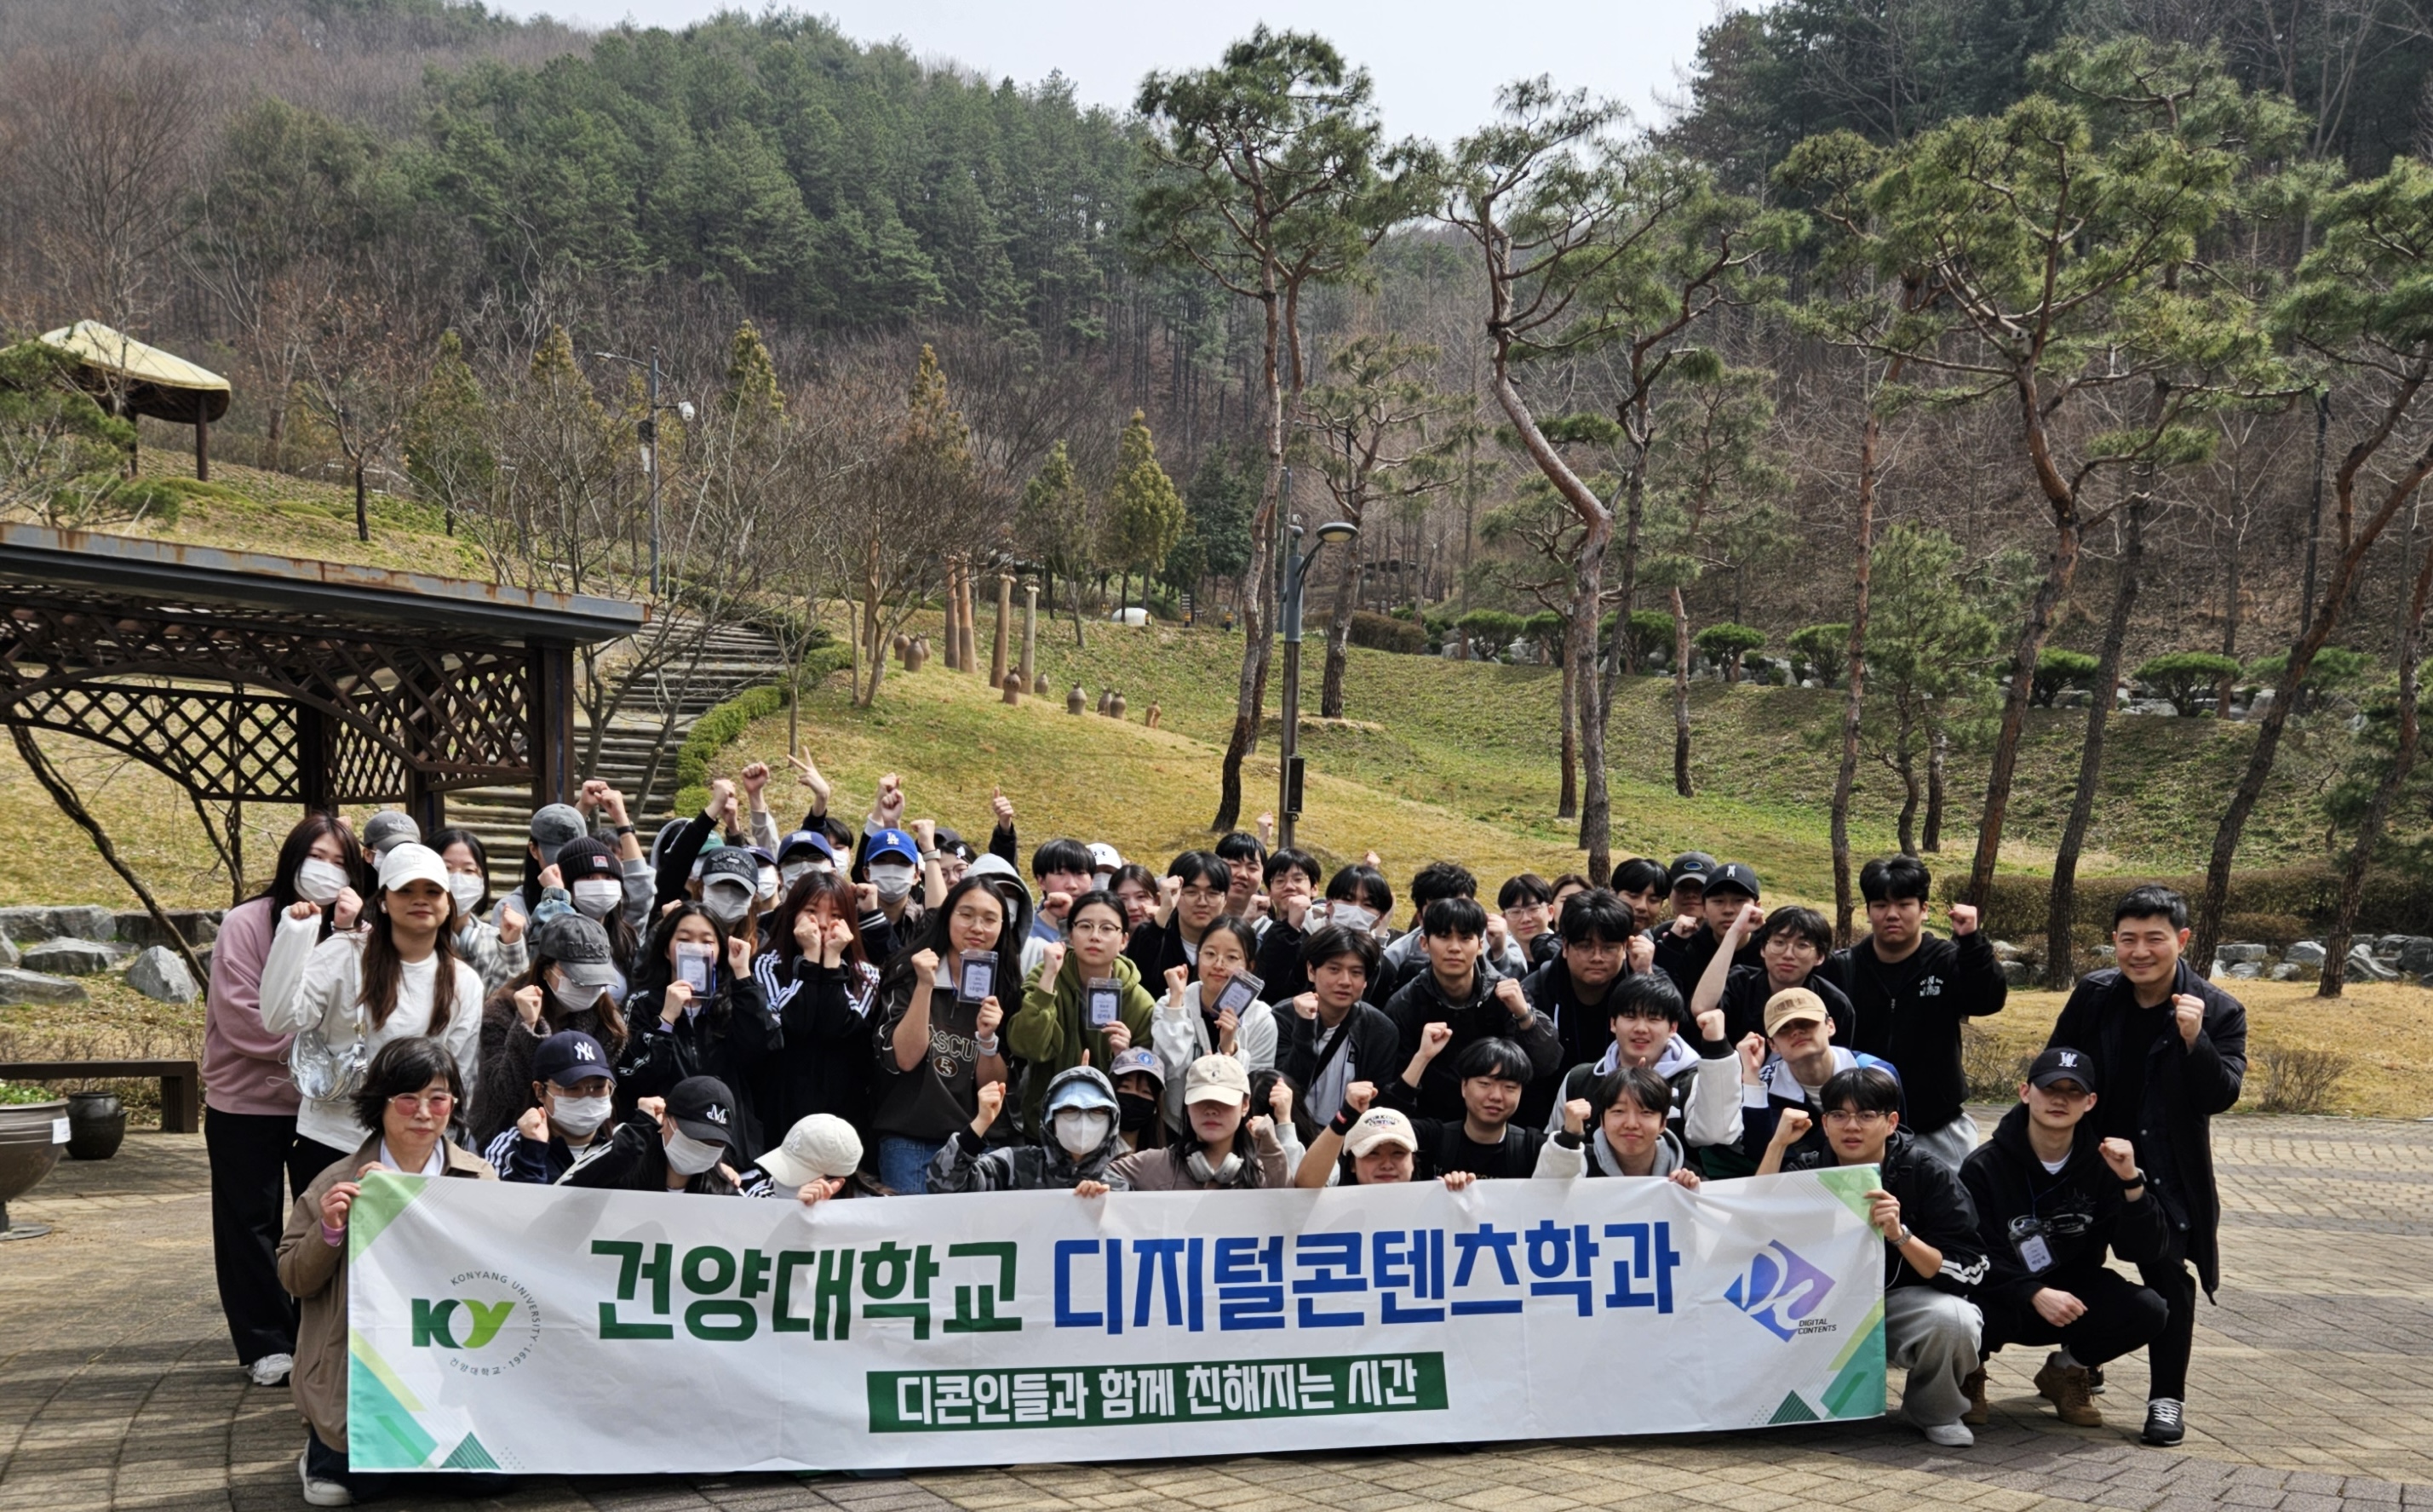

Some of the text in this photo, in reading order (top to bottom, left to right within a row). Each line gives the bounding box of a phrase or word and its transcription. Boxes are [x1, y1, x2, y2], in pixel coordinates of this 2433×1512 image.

[887, 832, 899, 845] LA
[711, 850, 755, 870] VINTAGE
[574, 1041, 595, 1061] NY
[591, 1220, 1680, 1341] 건양대학교 디지털콘텐츠학과
[450, 1271, 542, 1343] KONYANG UNIVERSITY
[1798, 1325, 1837, 1335] CONTENTS
[1799, 1319, 1828, 1327] DIGITAL
[450, 1357, 502, 1377] 건양대학교
[897, 1359, 1418, 1425] 디콘인들과 함께 친해지는 시간
